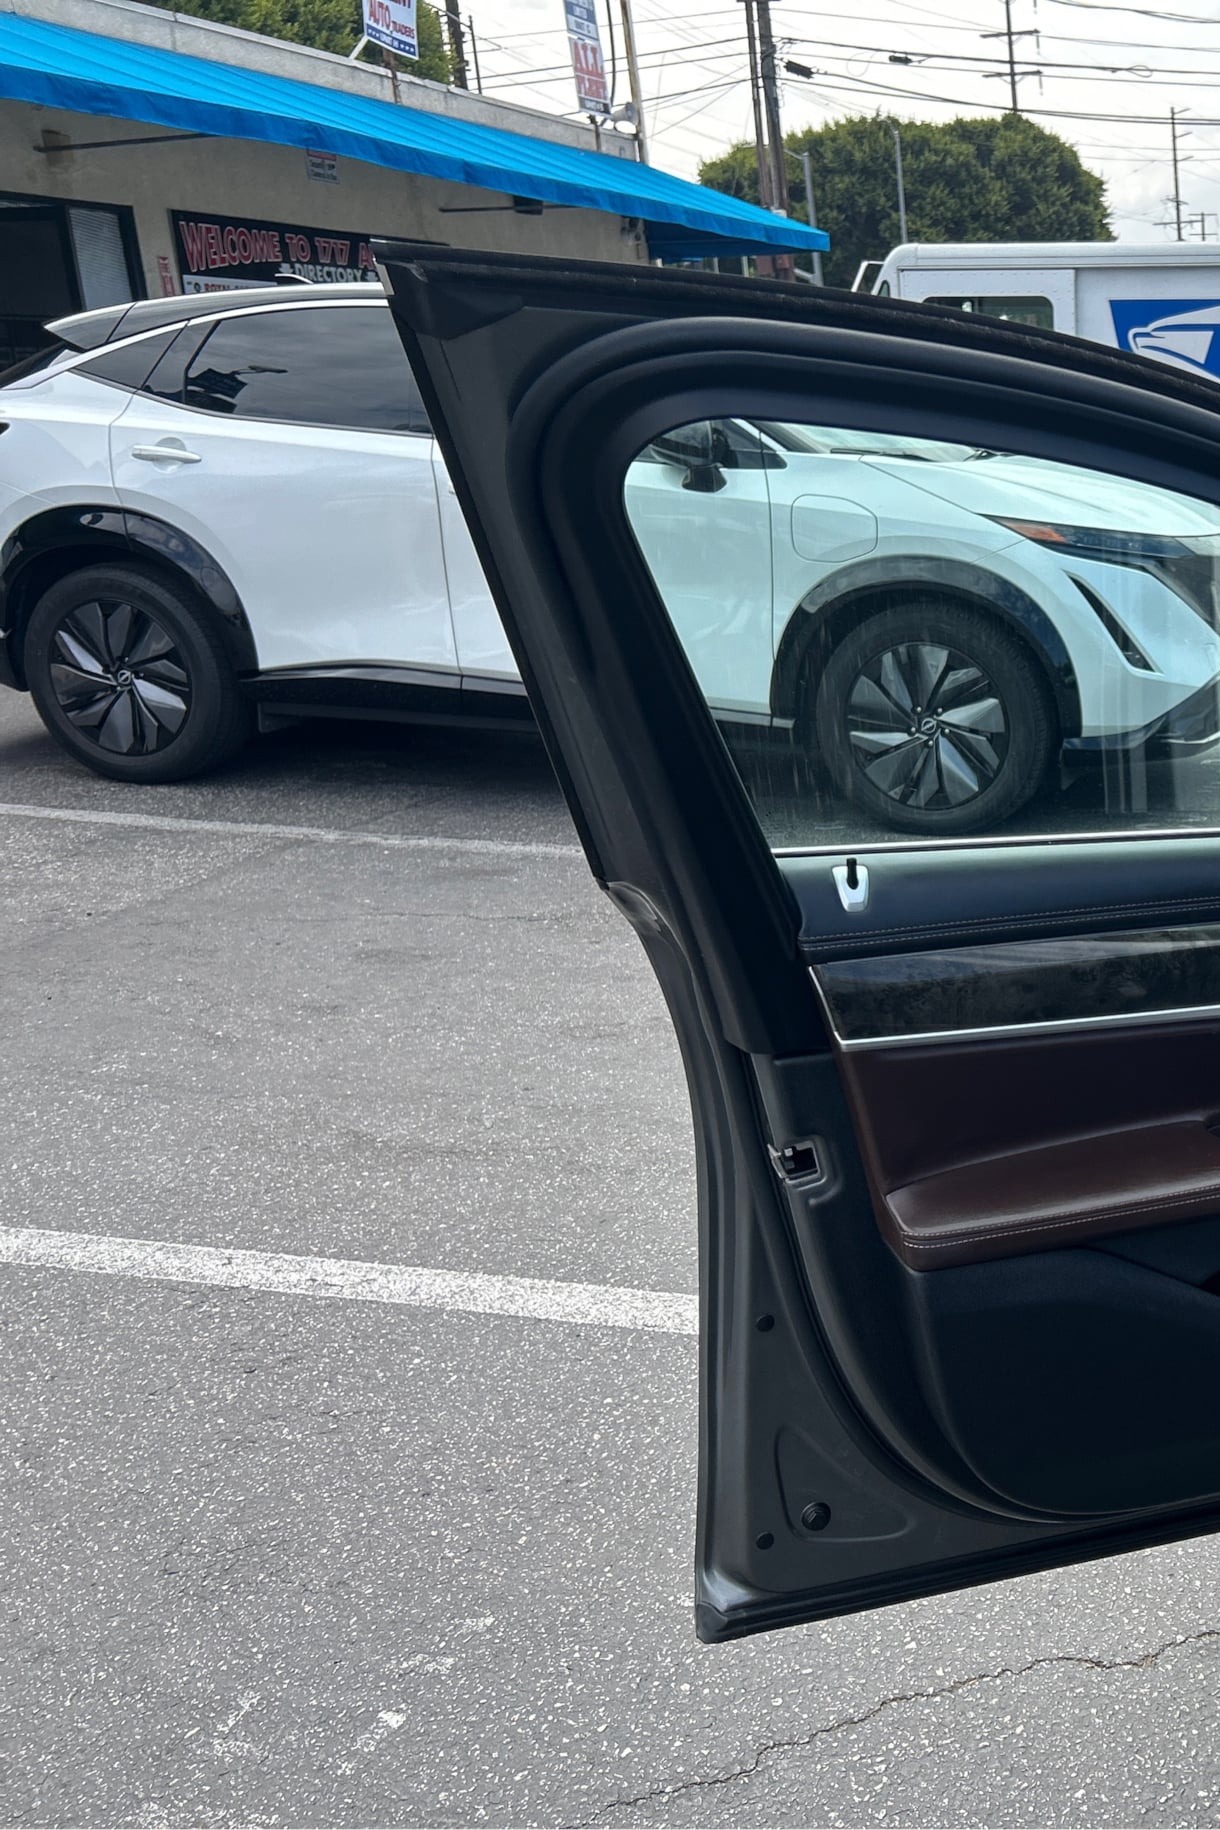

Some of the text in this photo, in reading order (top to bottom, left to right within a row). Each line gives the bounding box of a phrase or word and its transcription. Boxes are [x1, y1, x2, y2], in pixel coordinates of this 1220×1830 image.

[368, 0, 391, 30] AUTO
[179, 221, 283, 273] WELCOME
[285, 233, 311, 263] TO
[314, 237, 350, 266] 1717
[295, 263, 363, 283] DIRECTORY
